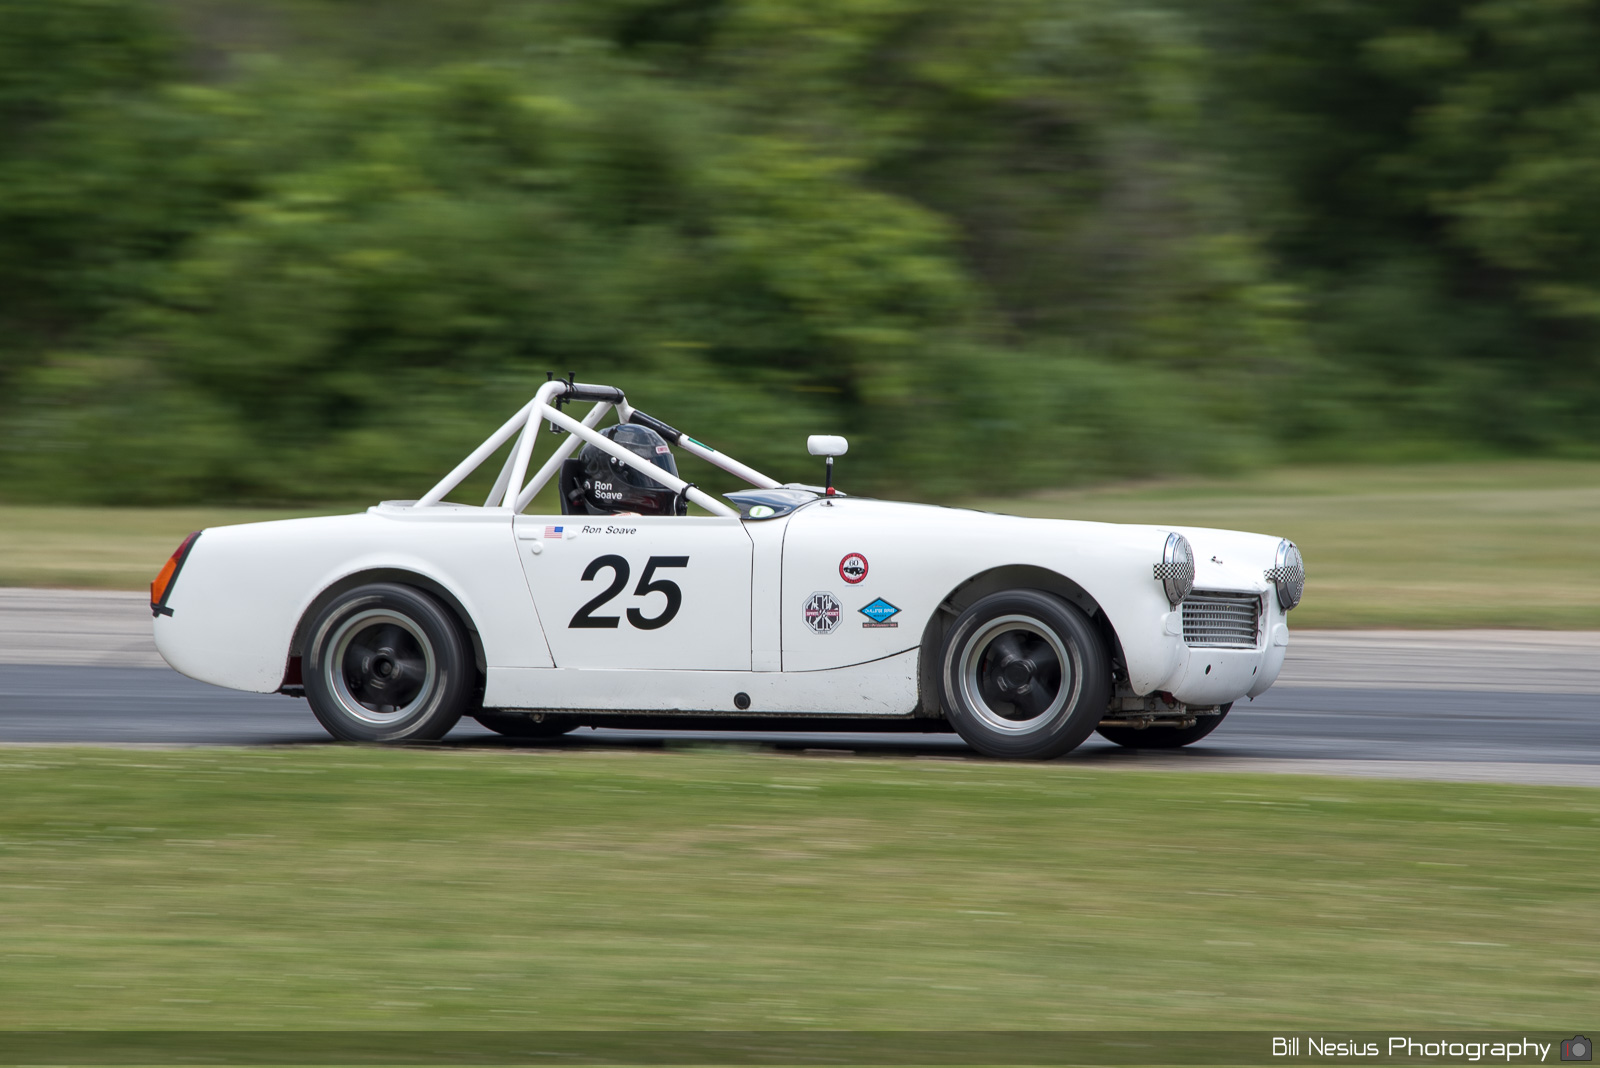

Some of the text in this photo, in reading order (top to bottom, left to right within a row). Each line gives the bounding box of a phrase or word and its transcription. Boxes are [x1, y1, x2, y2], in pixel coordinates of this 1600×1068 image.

[594, 481, 612, 491] Ron
[595, 490, 623, 500] Soave
[581, 525, 637, 535] Ron Soave
[568, 553, 690, 630] 25
